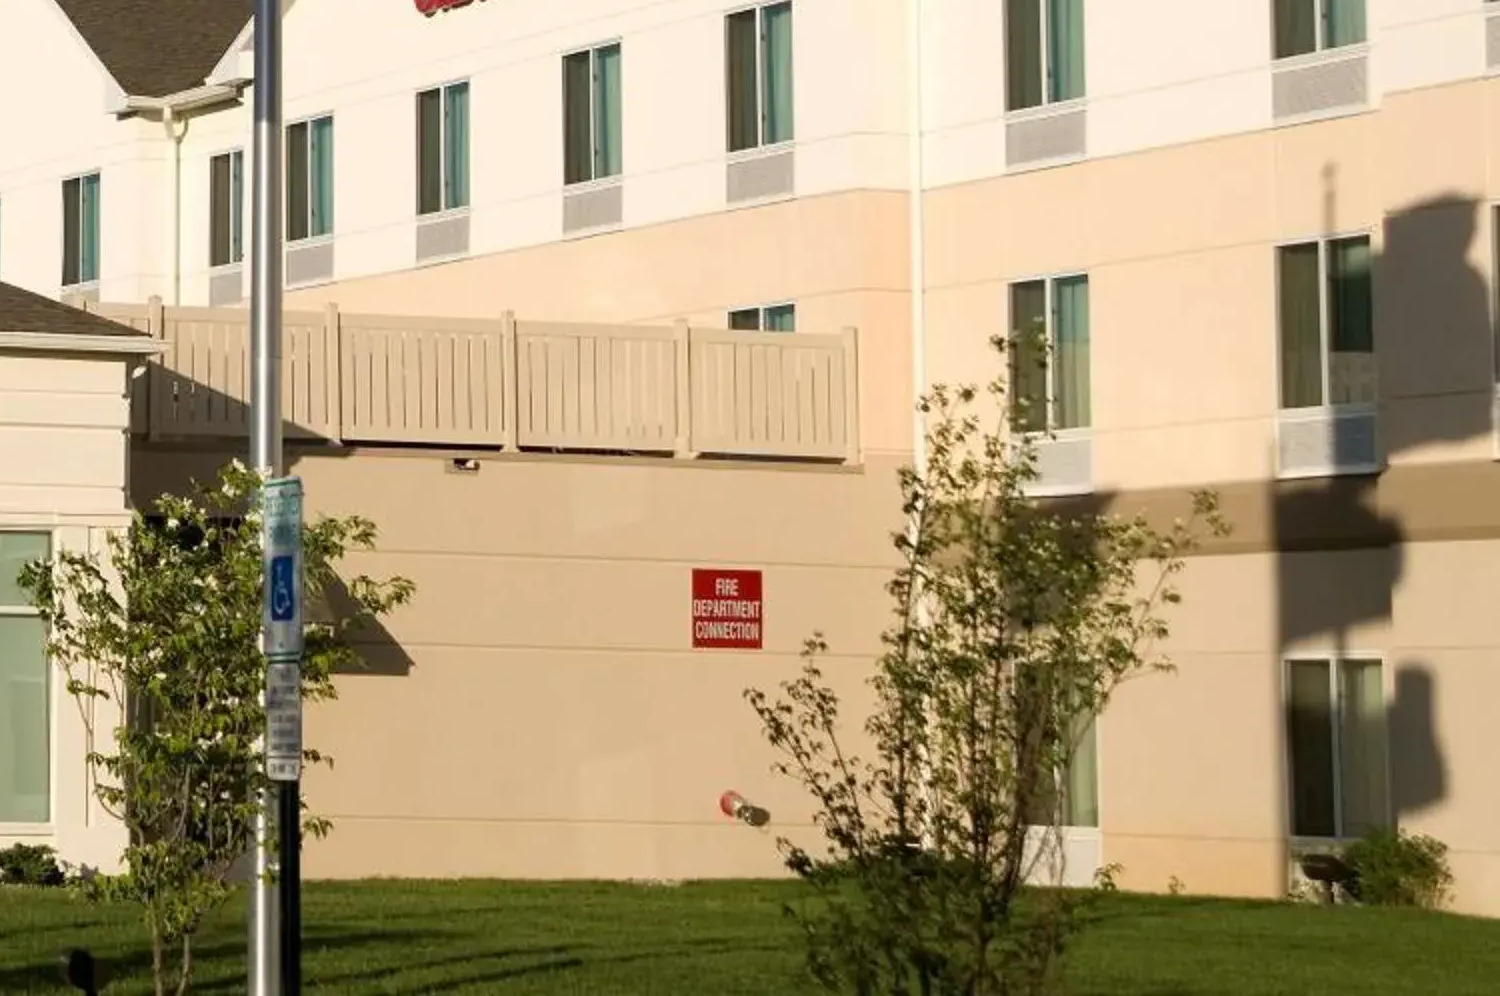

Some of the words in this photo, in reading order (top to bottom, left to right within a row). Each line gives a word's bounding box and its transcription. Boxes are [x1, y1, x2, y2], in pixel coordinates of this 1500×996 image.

[715, 577, 739, 597] FIRE
[693, 599, 760, 618] DEPARTMENT
[695, 621, 759, 640] CONNECTION
